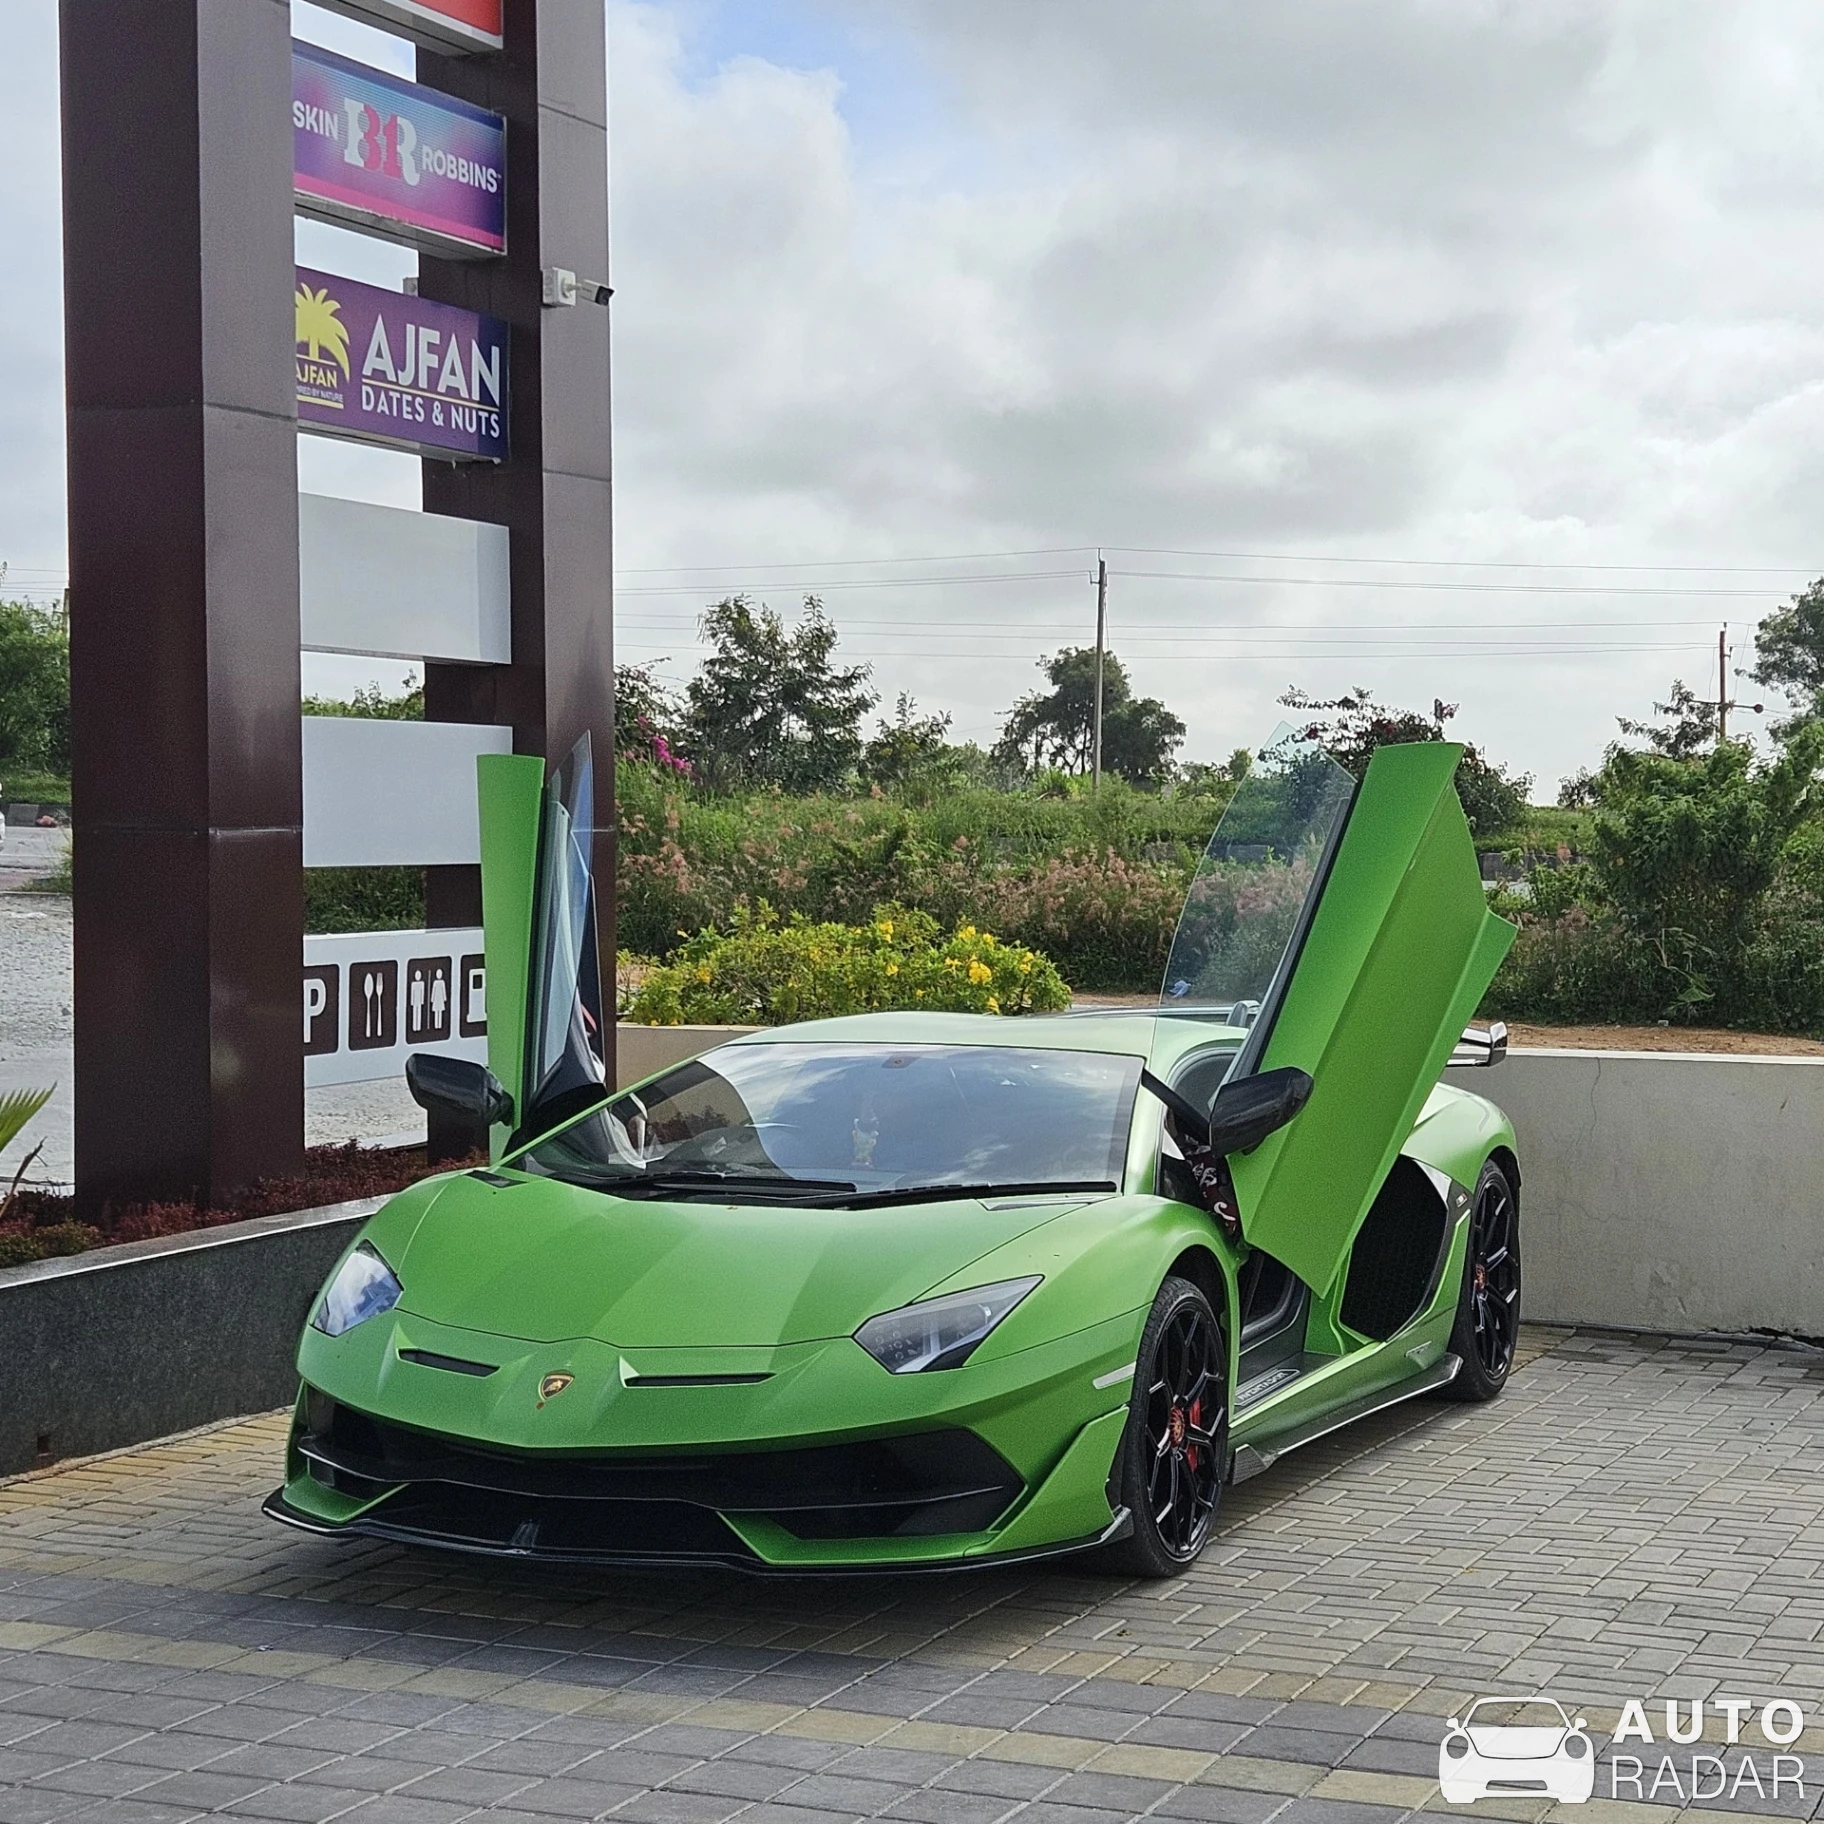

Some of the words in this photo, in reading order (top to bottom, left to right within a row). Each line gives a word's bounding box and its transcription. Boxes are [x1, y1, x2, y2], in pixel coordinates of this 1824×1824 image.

[422, 144, 498, 193] ROBBINS
[362, 313, 500, 407] AJFAN
[362, 385, 425, 423] DATES
[432, 402, 445, 427] &
[451, 405, 500, 438] NUTS
[303, 978, 327, 1043] P
